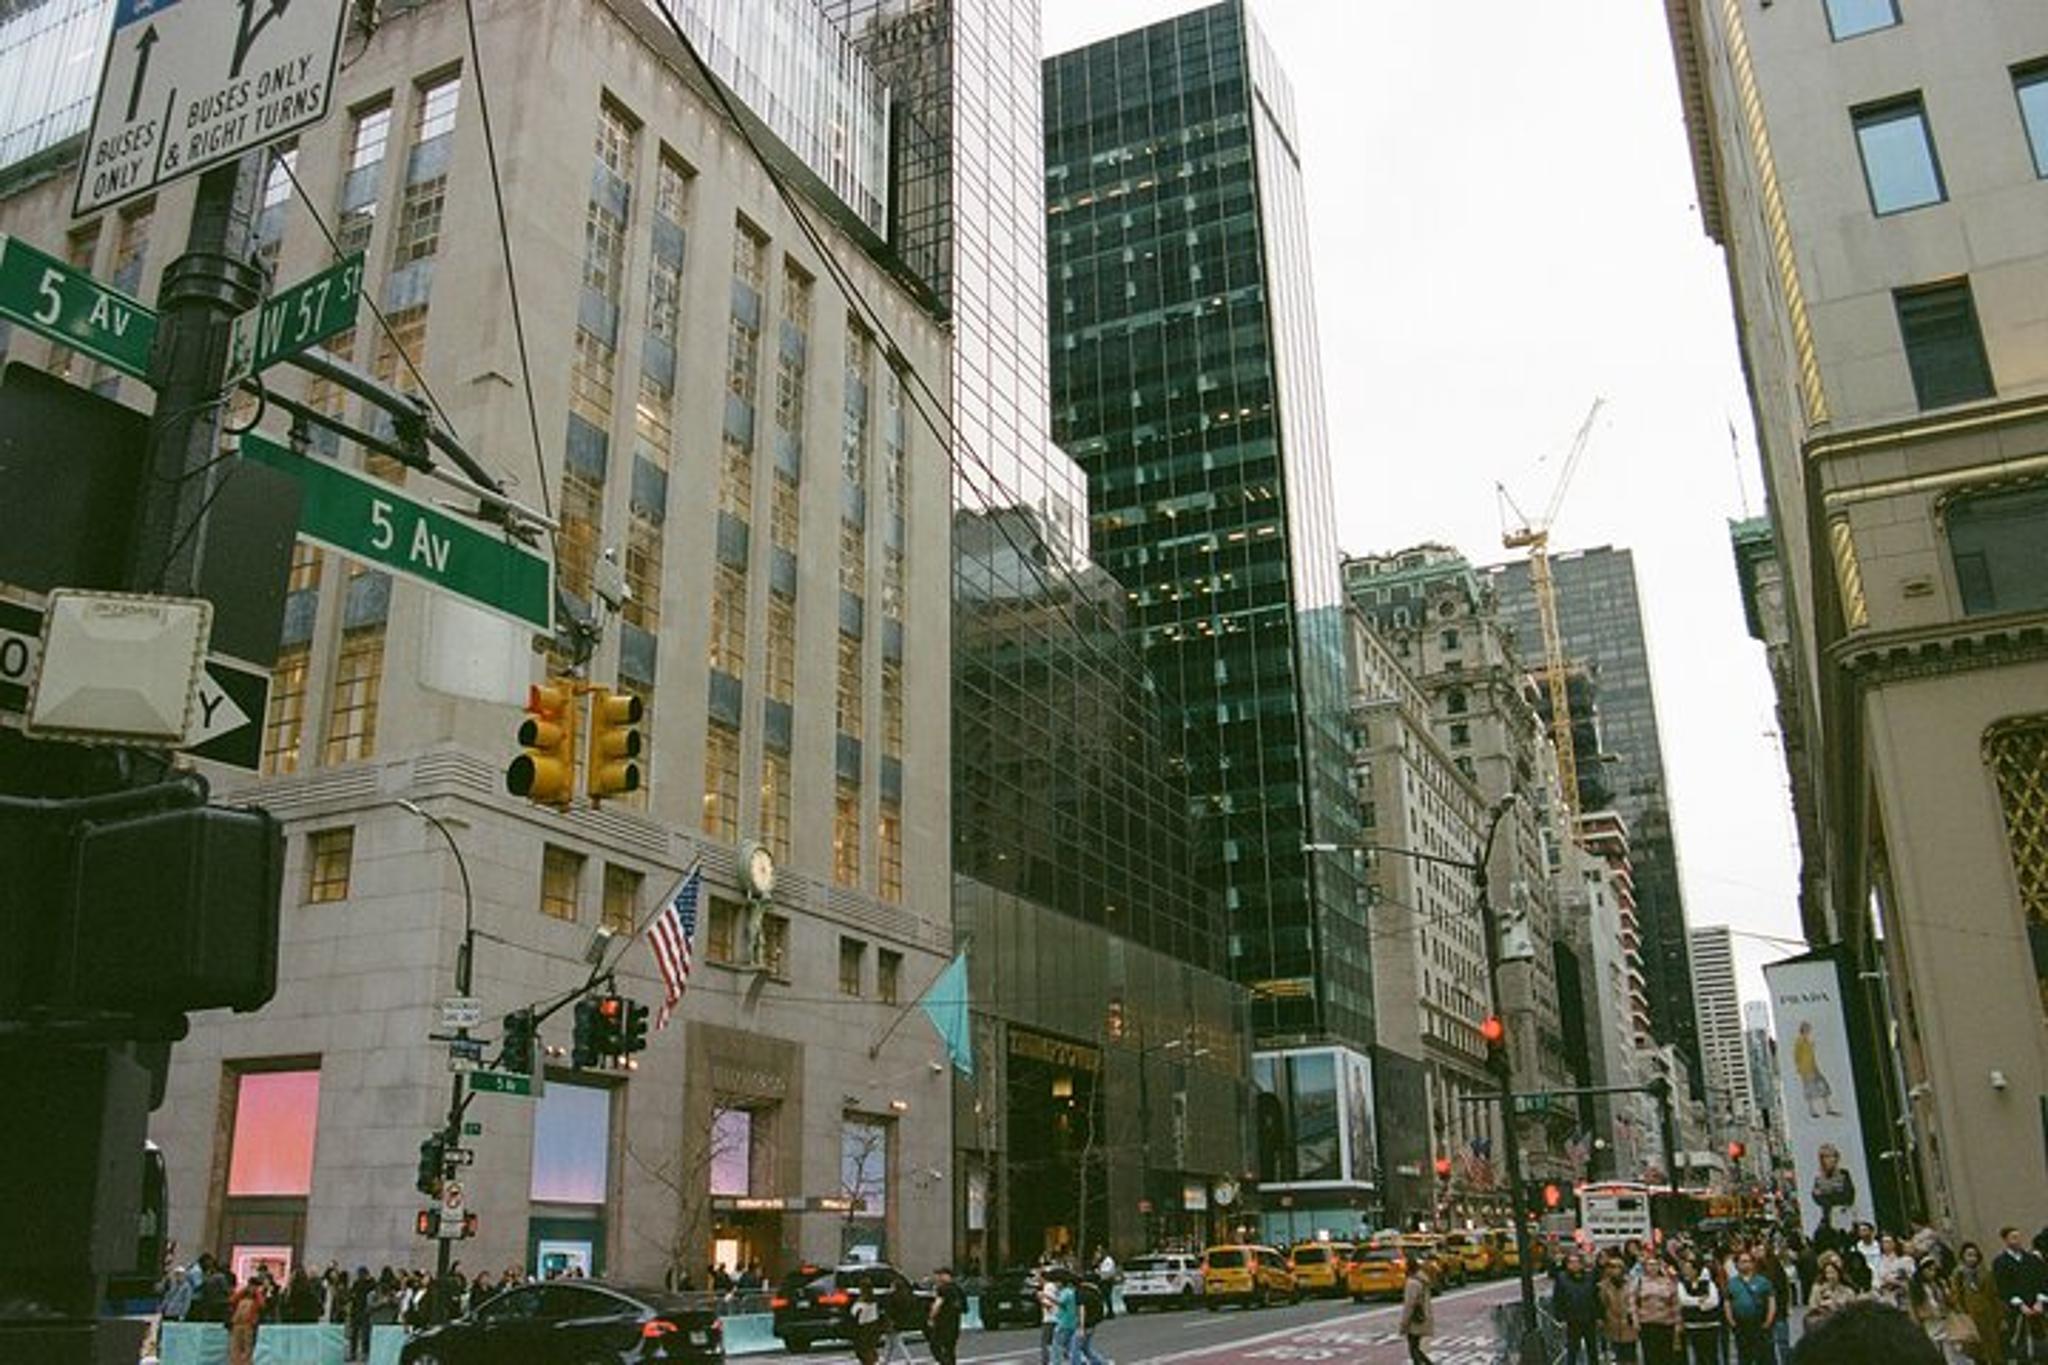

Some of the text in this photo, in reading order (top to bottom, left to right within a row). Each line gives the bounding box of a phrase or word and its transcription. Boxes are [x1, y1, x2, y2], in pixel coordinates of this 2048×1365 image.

[164, 82, 321, 171] & RIGHT TURNS
[187, 53, 313, 130] BUSES ONLY
[92, 120, 157, 200] BUSES ONLY
[32, 267, 66, 325] 5
[261, 300, 289, 359] W
[295, 278, 332, 342] 57
[371, 499, 394, 550] 5
